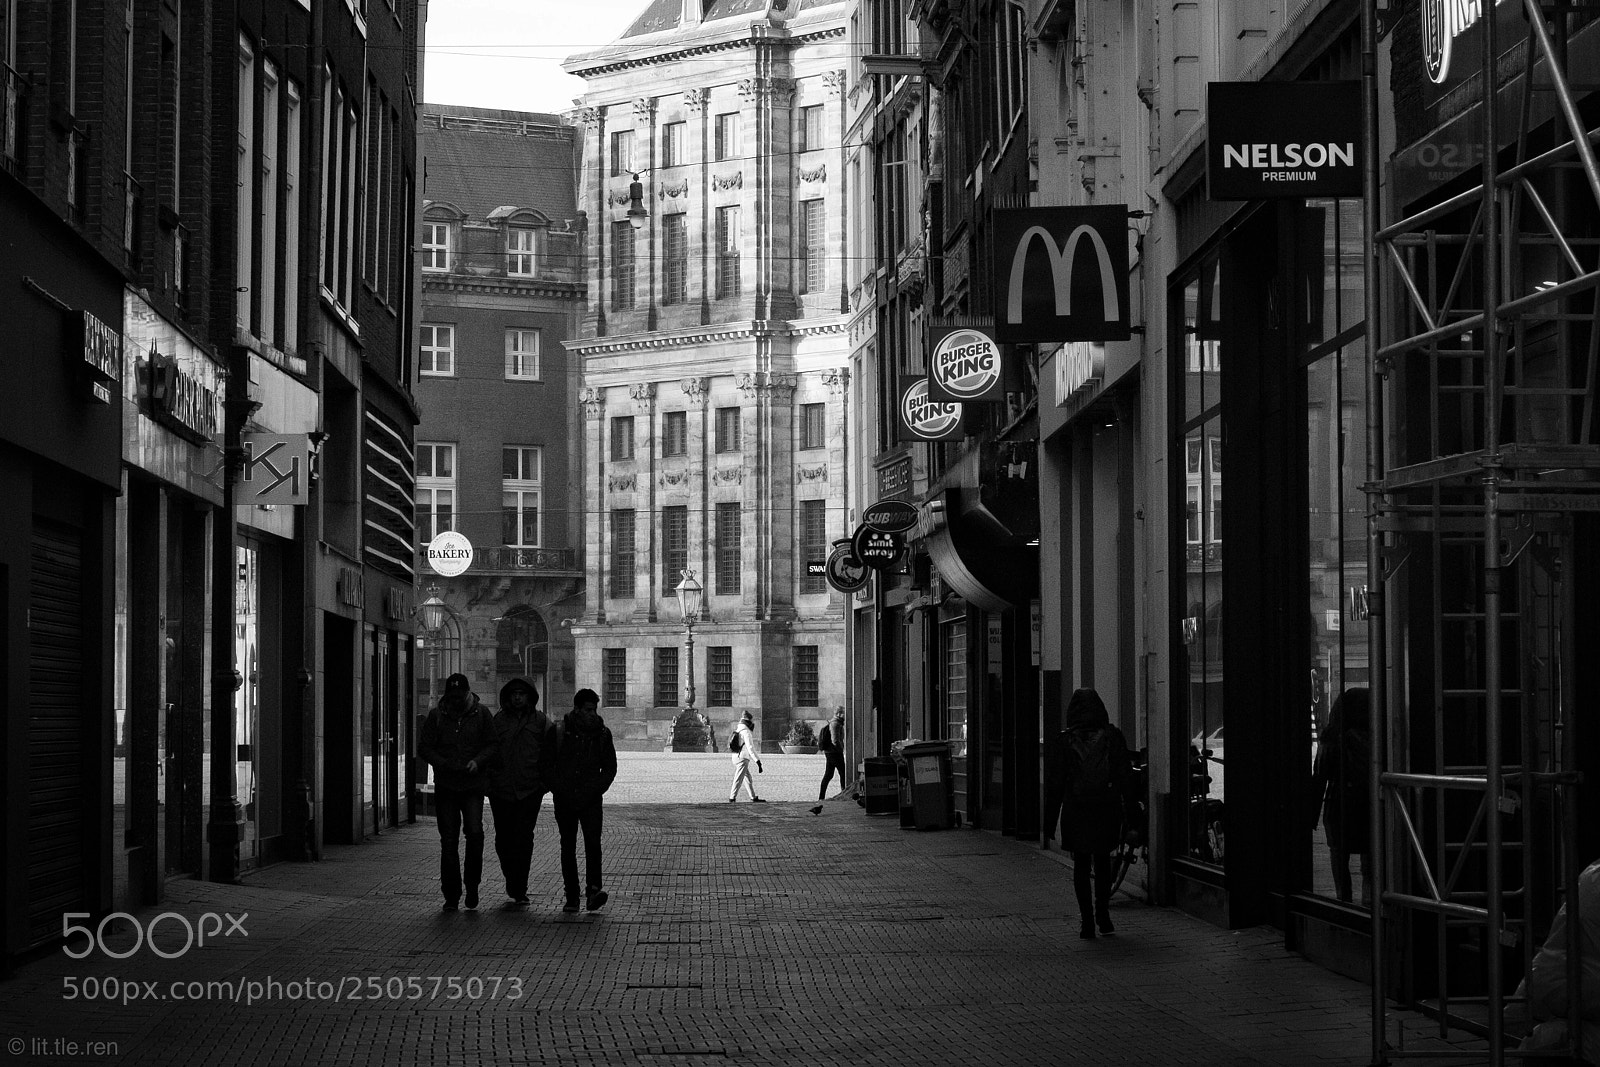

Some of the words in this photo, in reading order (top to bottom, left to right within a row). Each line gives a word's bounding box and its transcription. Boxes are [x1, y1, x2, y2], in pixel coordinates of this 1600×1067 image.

[1223, 142, 1354, 168] NELSON
[1262, 170, 1317, 182] PREMIUM
[940, 341, 992, 367] BURGER
[942, 353, 994, 384] KING
[910, 402, 956, 426] KING
[865, 511, 918, 525] SUBWAY
[867, 533, 894, 547] simit
[429, 549, 471, 559] BAKERY
